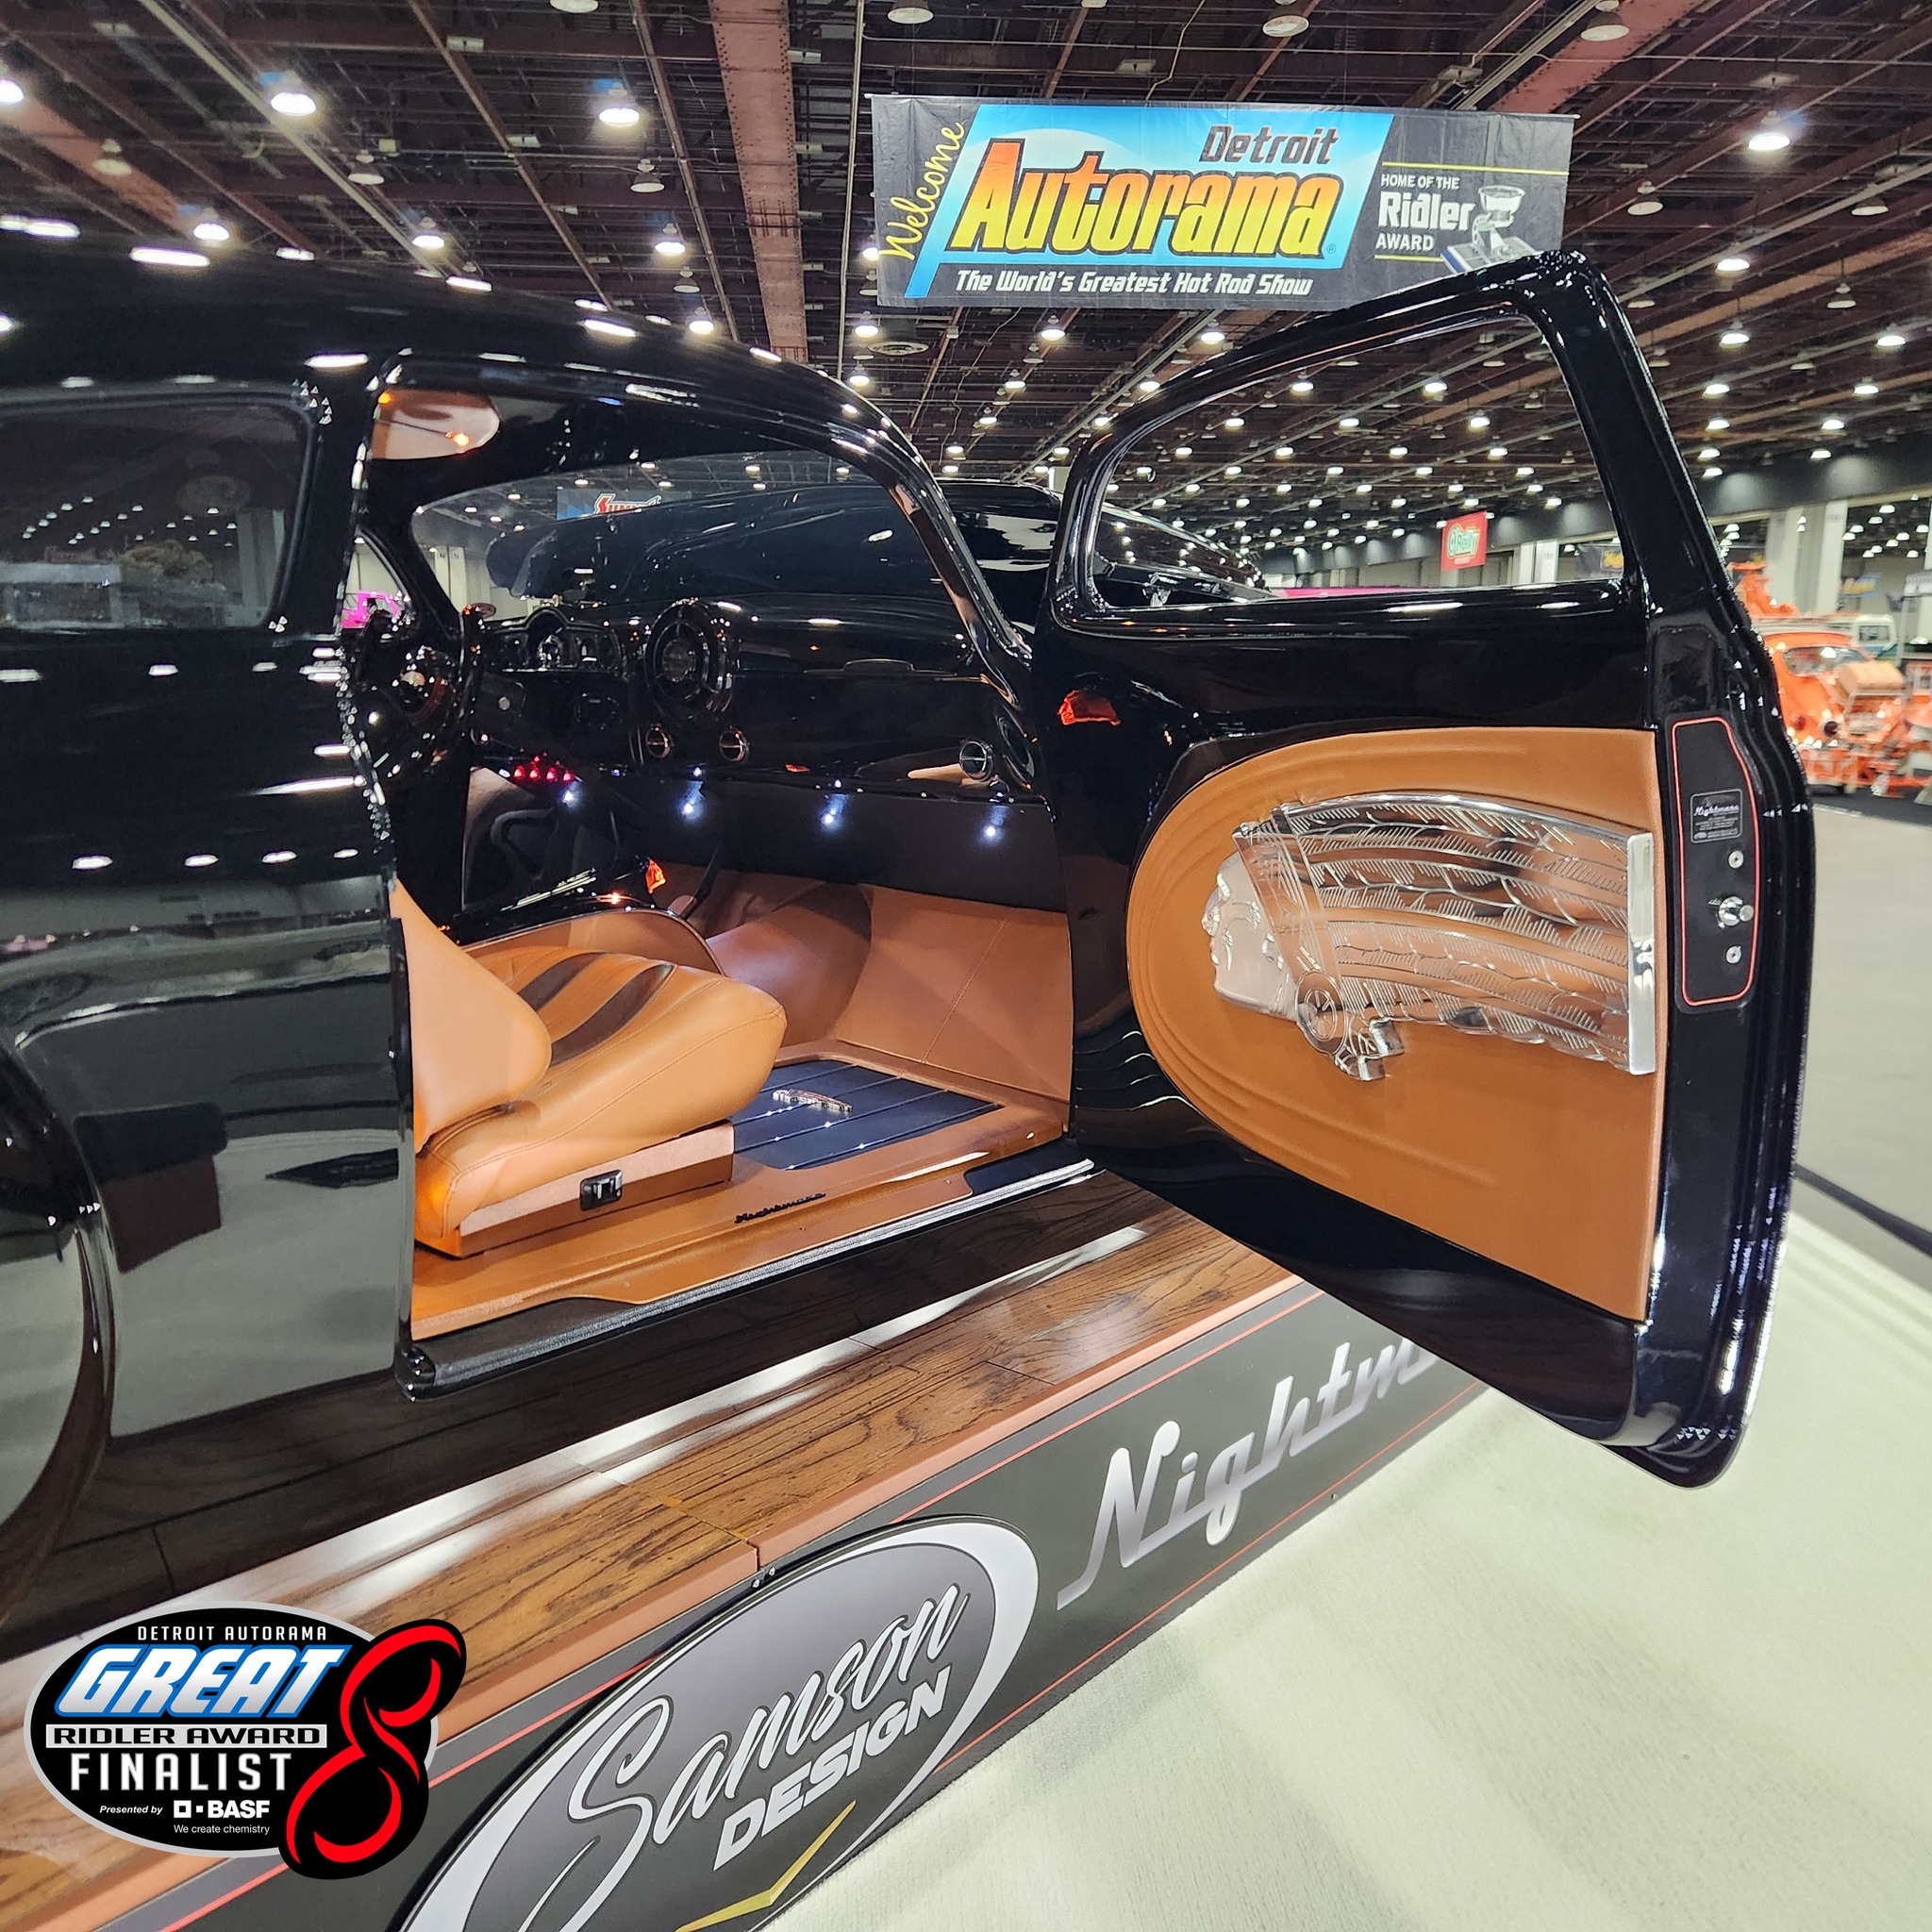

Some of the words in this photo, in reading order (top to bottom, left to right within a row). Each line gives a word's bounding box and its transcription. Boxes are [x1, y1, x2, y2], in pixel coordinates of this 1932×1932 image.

[1199, 124, 1340, 165] Detroit
[1381, 174, 1414, 188] HOME
[1417, 175, 1435, 189] OF
[1437, 175, 1460, 190] THE
[878, 121, 967, 261] Welcome
[946, 139, 1344, 258] Autorama
[1378, 191, 1475, 231] Ridler
[1375, 233, 1435, 251] AWARD
[956, 270, 990, 291] The
[996, 270, 1074, 292] World's
[1077, 271, 1172, 293] Greatest
[1173, 272, 1212, 294] Hot
[1213, 273, 1255, 294] Rod
[1256, 274, 1313, 295] Show
[1057, 1337, 1439, 1611] Nightm
[517, 1584, 969, 1932] Samson
[713, 1665, 951, 1872] DESIGN
